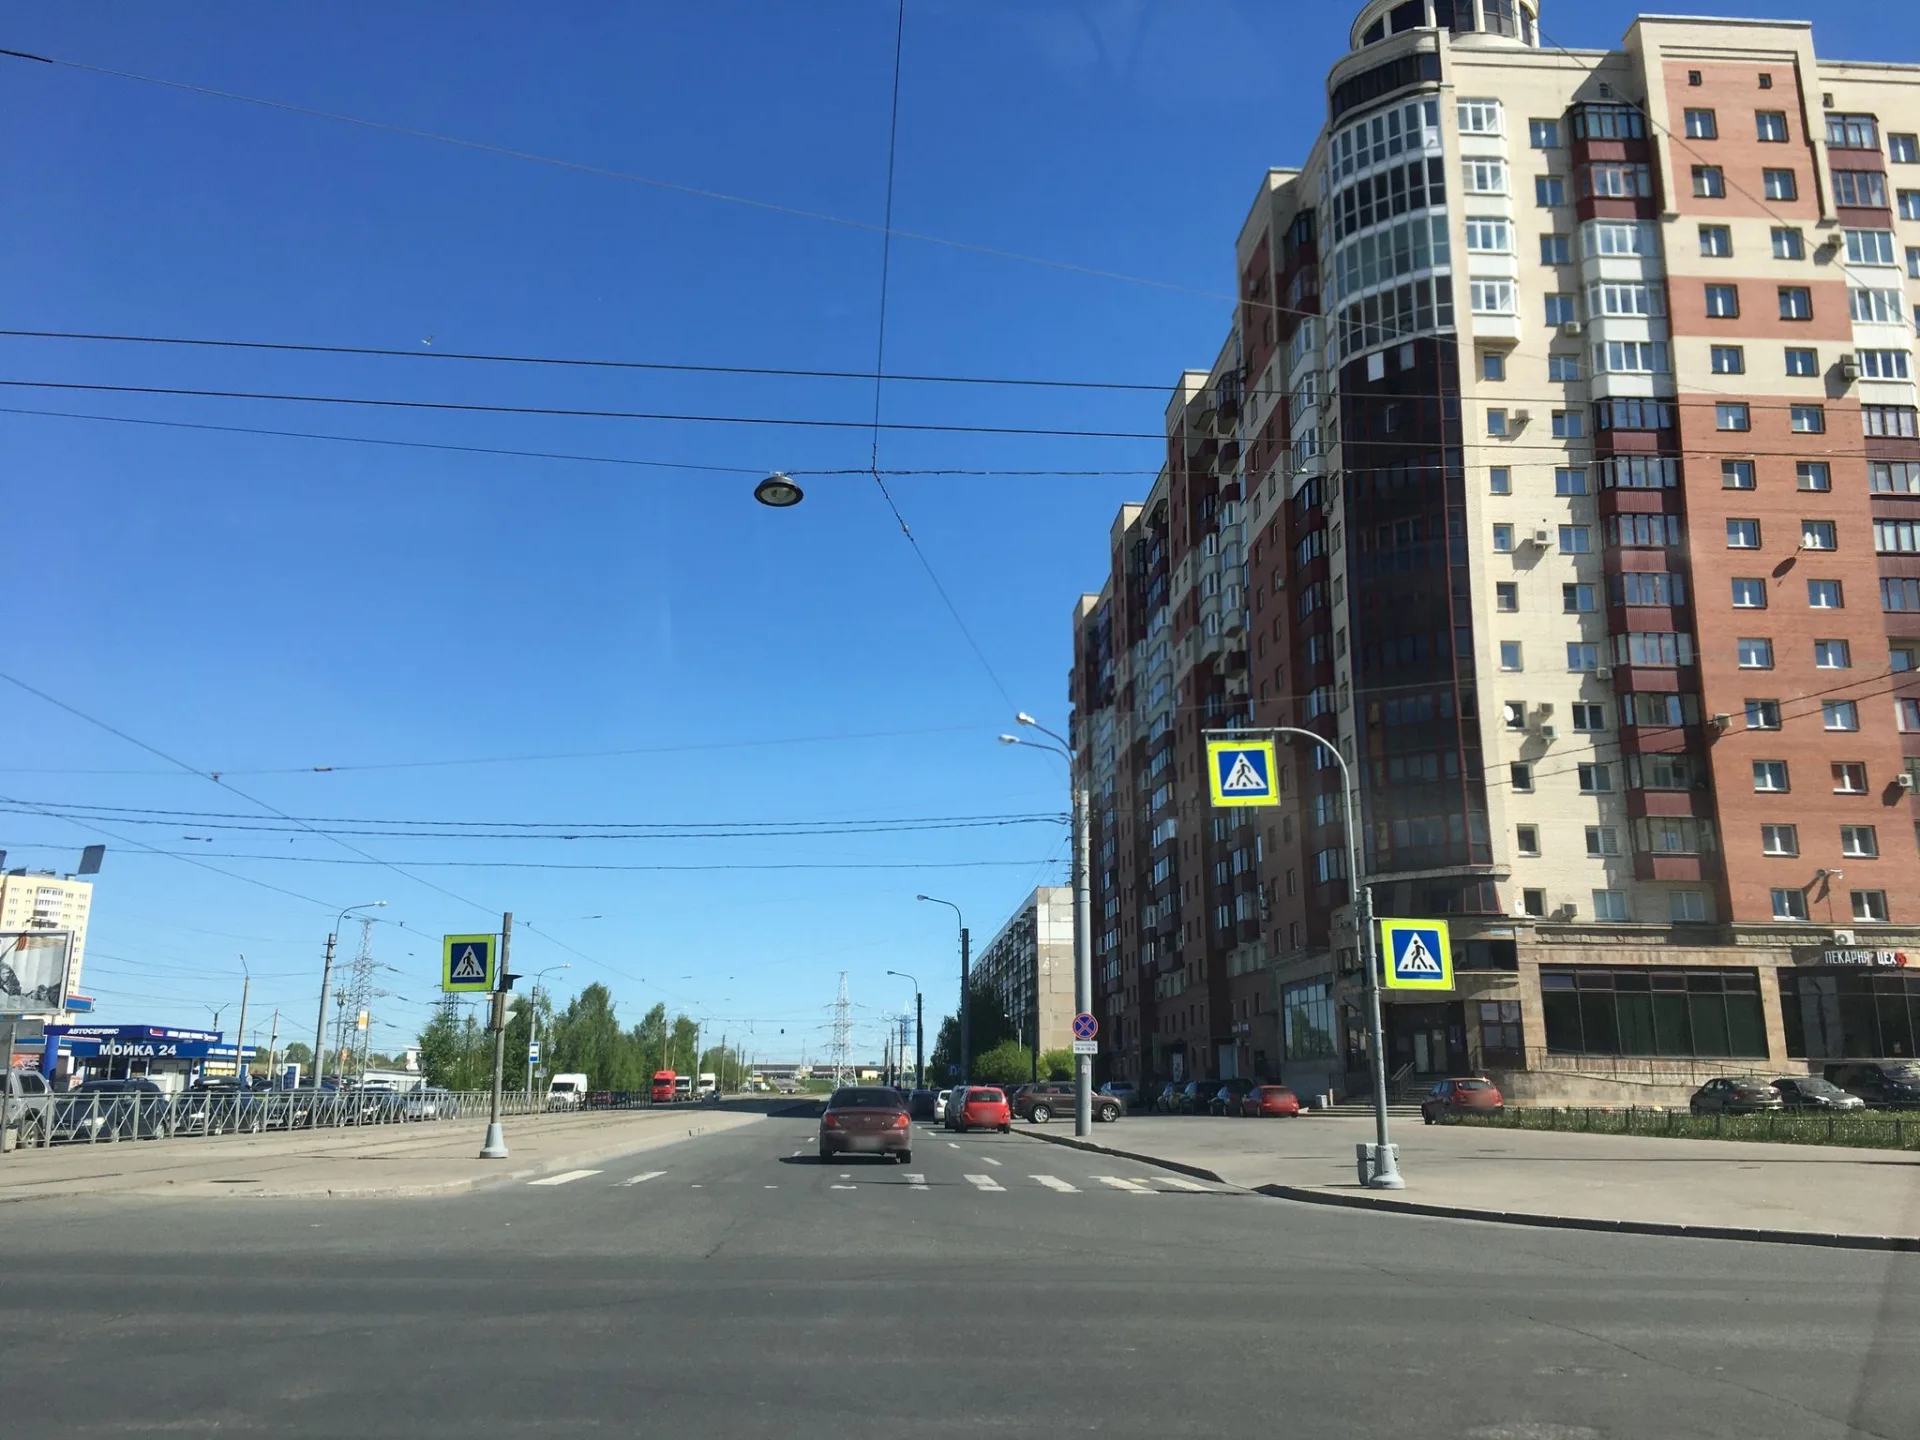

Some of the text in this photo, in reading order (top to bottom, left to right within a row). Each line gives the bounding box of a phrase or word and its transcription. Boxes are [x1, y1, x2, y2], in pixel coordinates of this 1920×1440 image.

[1824, 951, 1870, 964] ПЕКАРНЯ
[99, 1042, 177, 1056] МОЙКА 24
